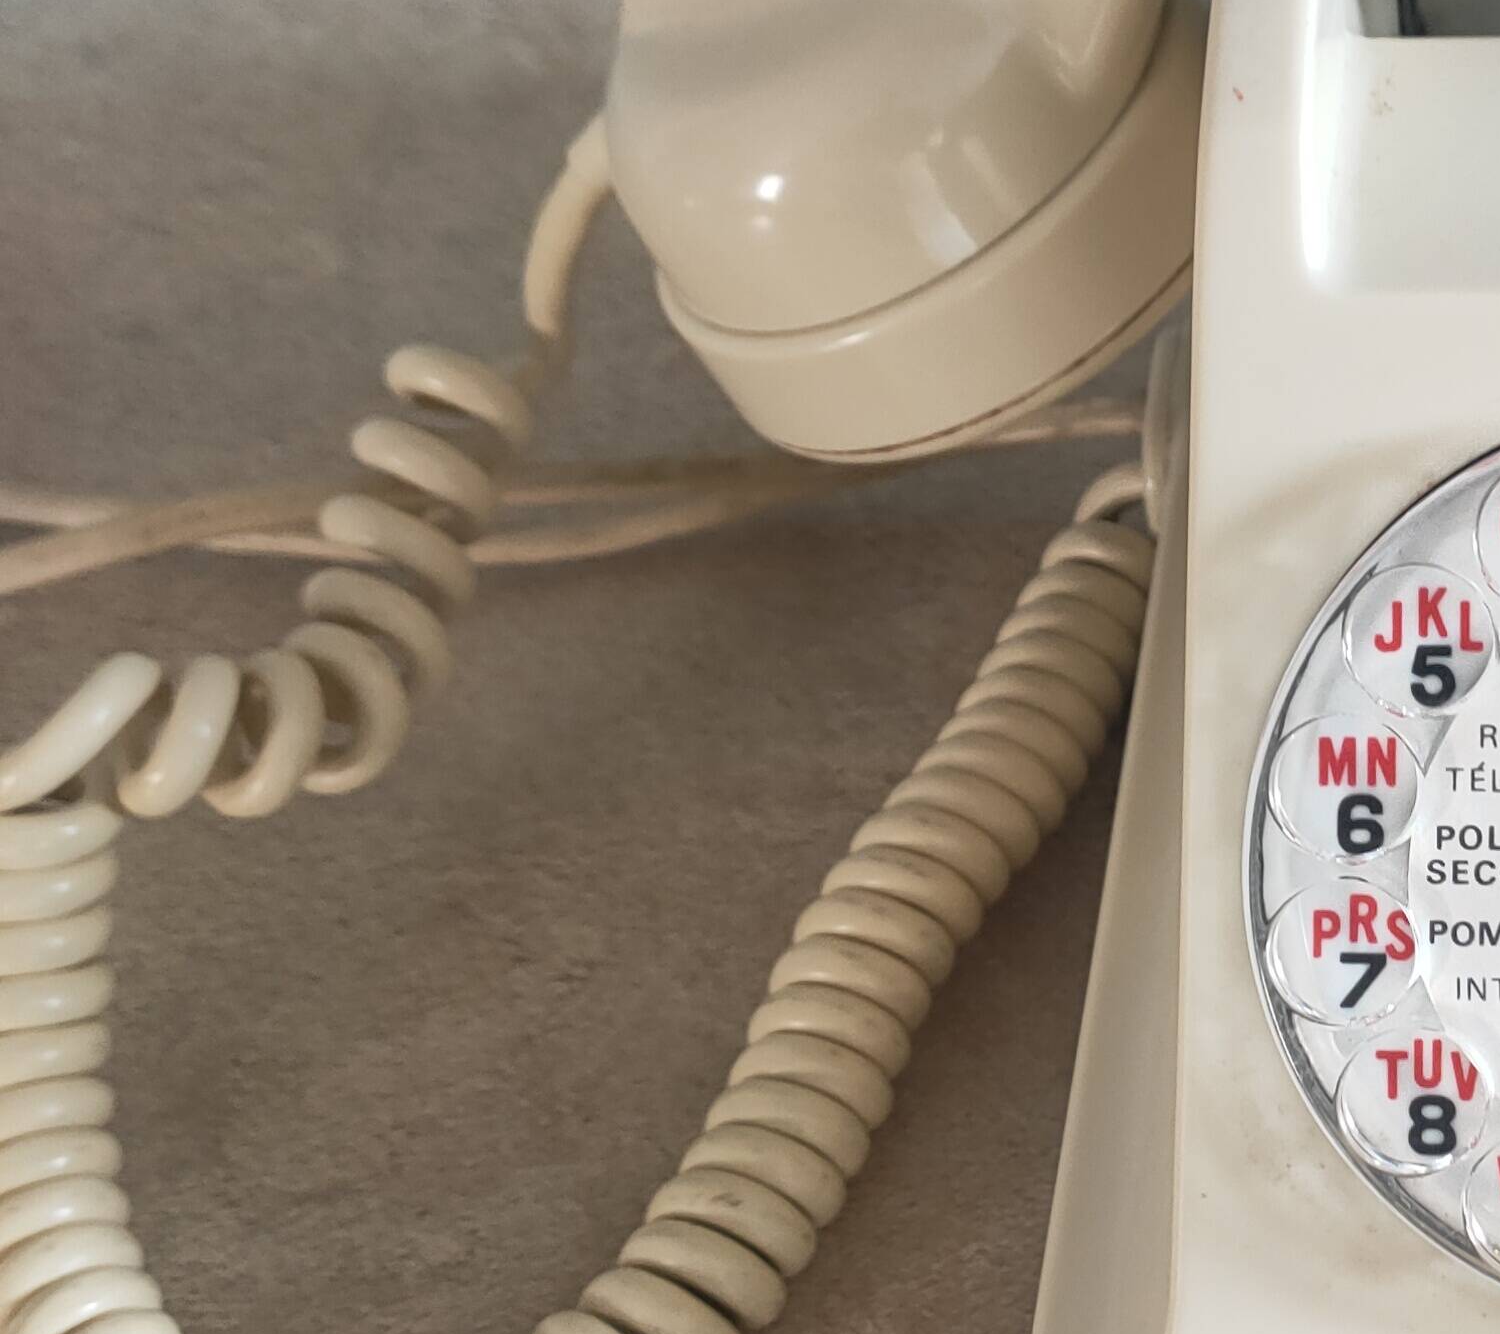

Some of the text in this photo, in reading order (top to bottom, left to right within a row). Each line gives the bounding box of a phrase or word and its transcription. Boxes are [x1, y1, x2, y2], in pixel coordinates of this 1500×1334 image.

[1374, 586, 1484, 653] JKL
[1410, 645, 1456, 707] 5
[1318, 736, 1397, 786] MN
[1336, 793, 1384, 854] 6
[1312, 893, 1415, 961] PRS
[1339, 953, 1386, 1009] 7
[1375, 1038, 1479, 1101] TUV
[1408, 1095, 1457, 1156] 8
